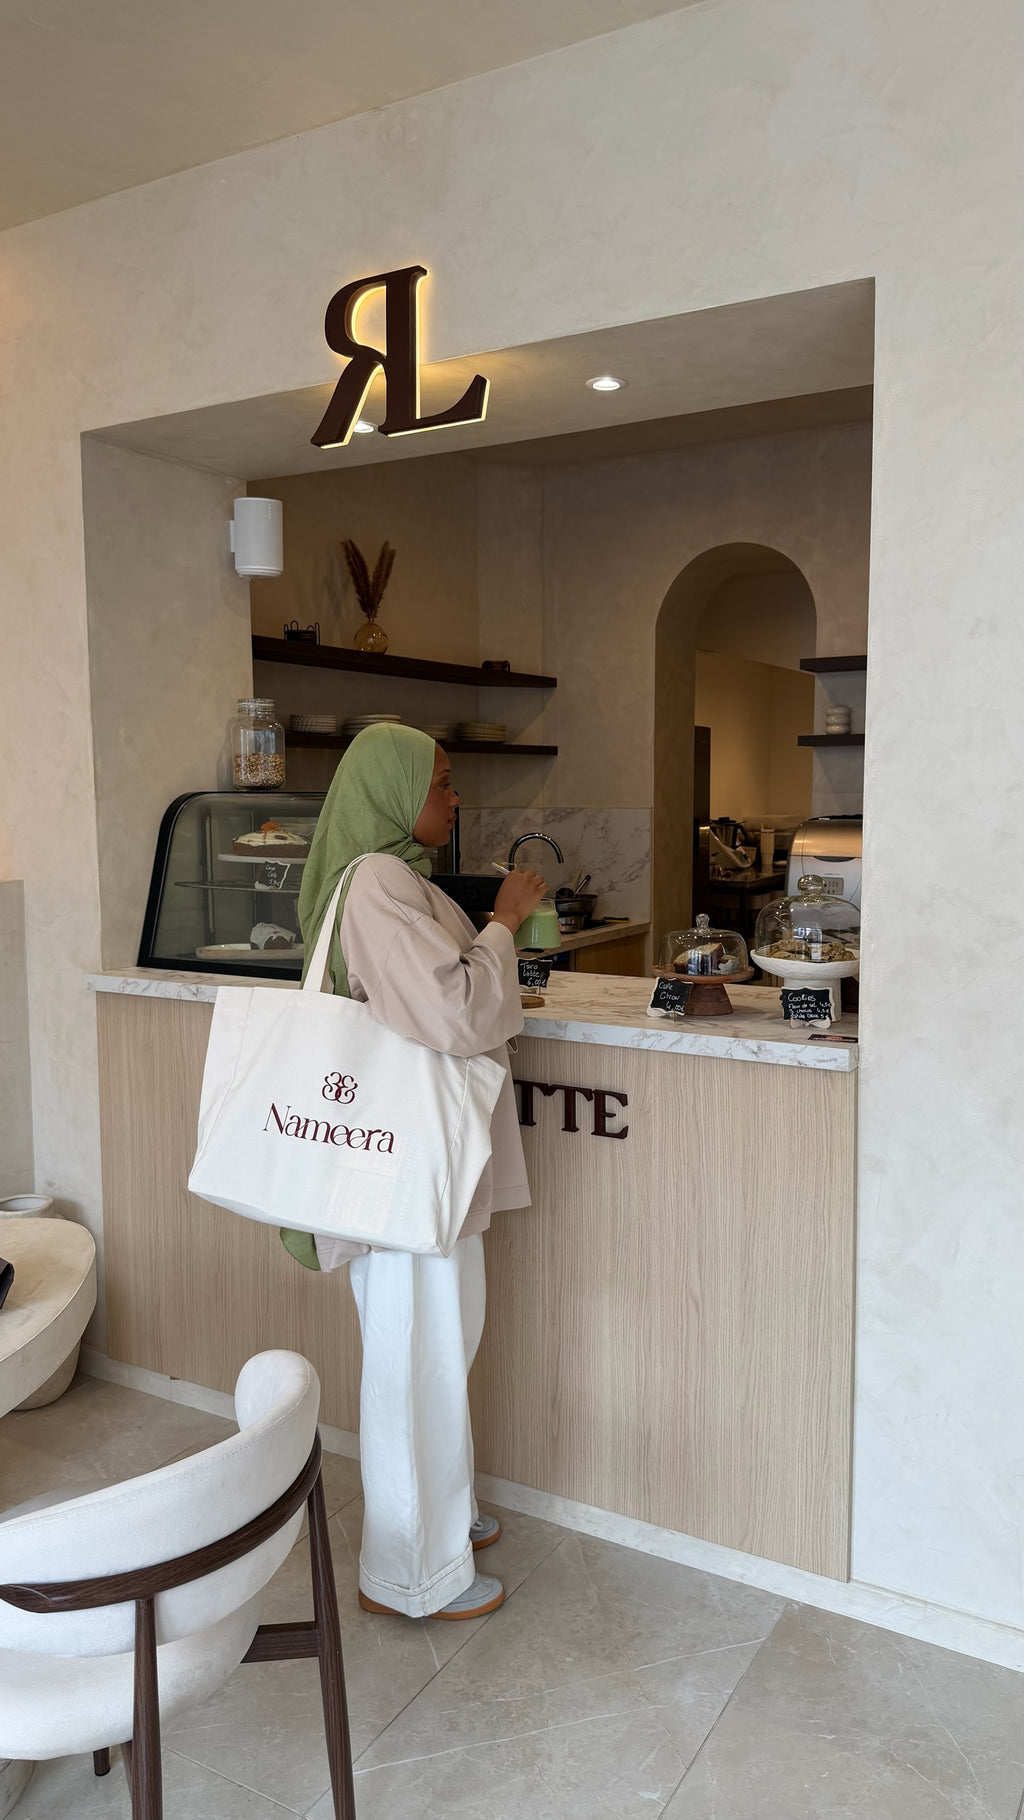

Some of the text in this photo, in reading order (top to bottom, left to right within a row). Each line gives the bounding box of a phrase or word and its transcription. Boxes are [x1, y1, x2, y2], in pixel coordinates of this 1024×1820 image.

[522, 969, 540, 978] Latte
[658, 981, 673, 991] Cake
[787, 993, 816, 1002] Cookies
[261, 1102, 395, 1154] Nameera
